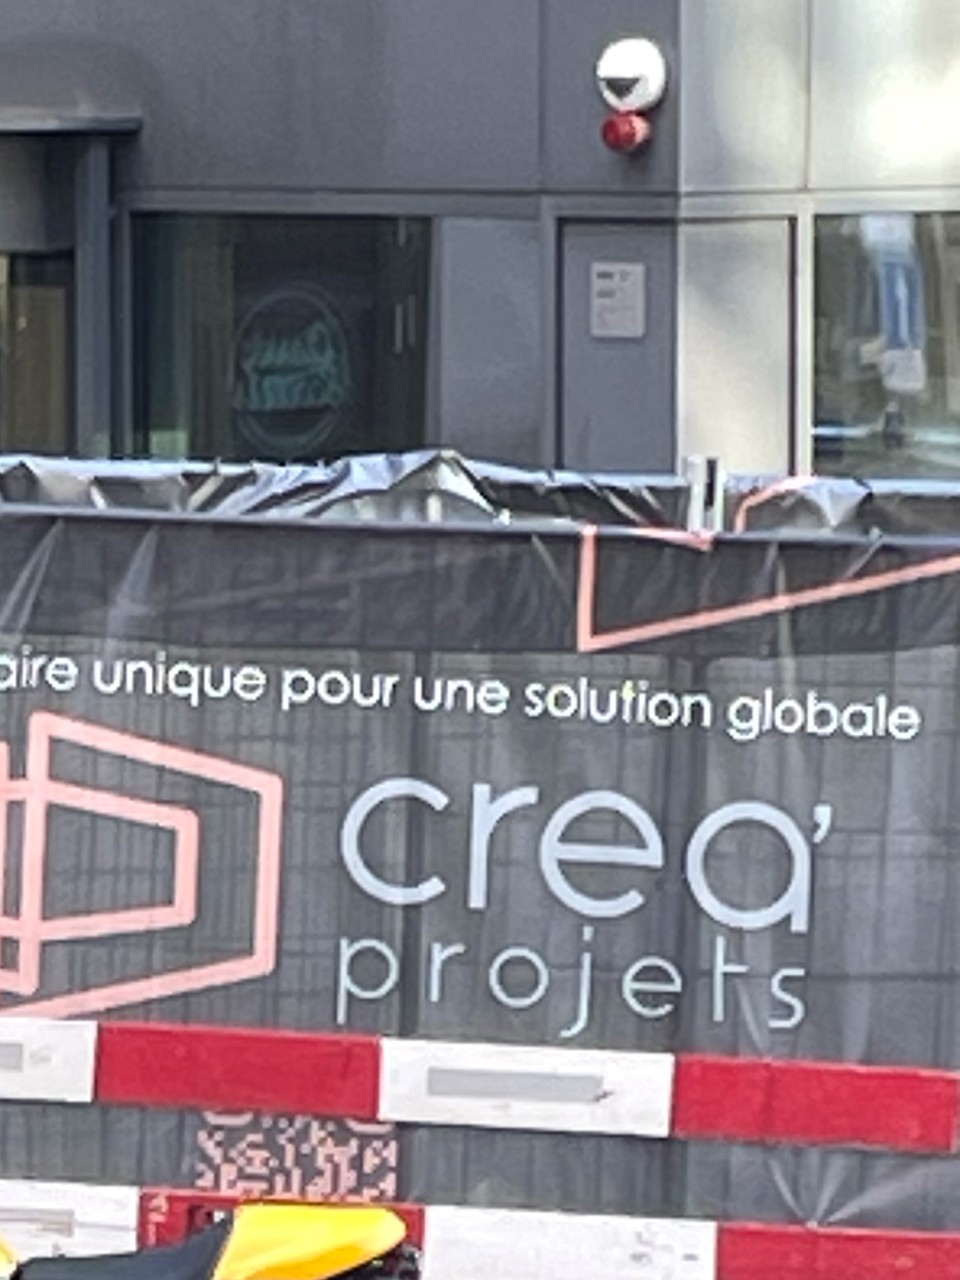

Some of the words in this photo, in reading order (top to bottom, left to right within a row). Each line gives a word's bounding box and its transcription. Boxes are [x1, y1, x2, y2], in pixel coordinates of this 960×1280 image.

[92, 652, 267, 706] unique
[281, 668, 400, 710] pour
[414, 677, 510, 714] une
[524, 676, 712, 728] solution
[727, 687, 922, 741] globale
[340, 776, 832, 934] crea'
[336, 925, 807, 1039] projets
